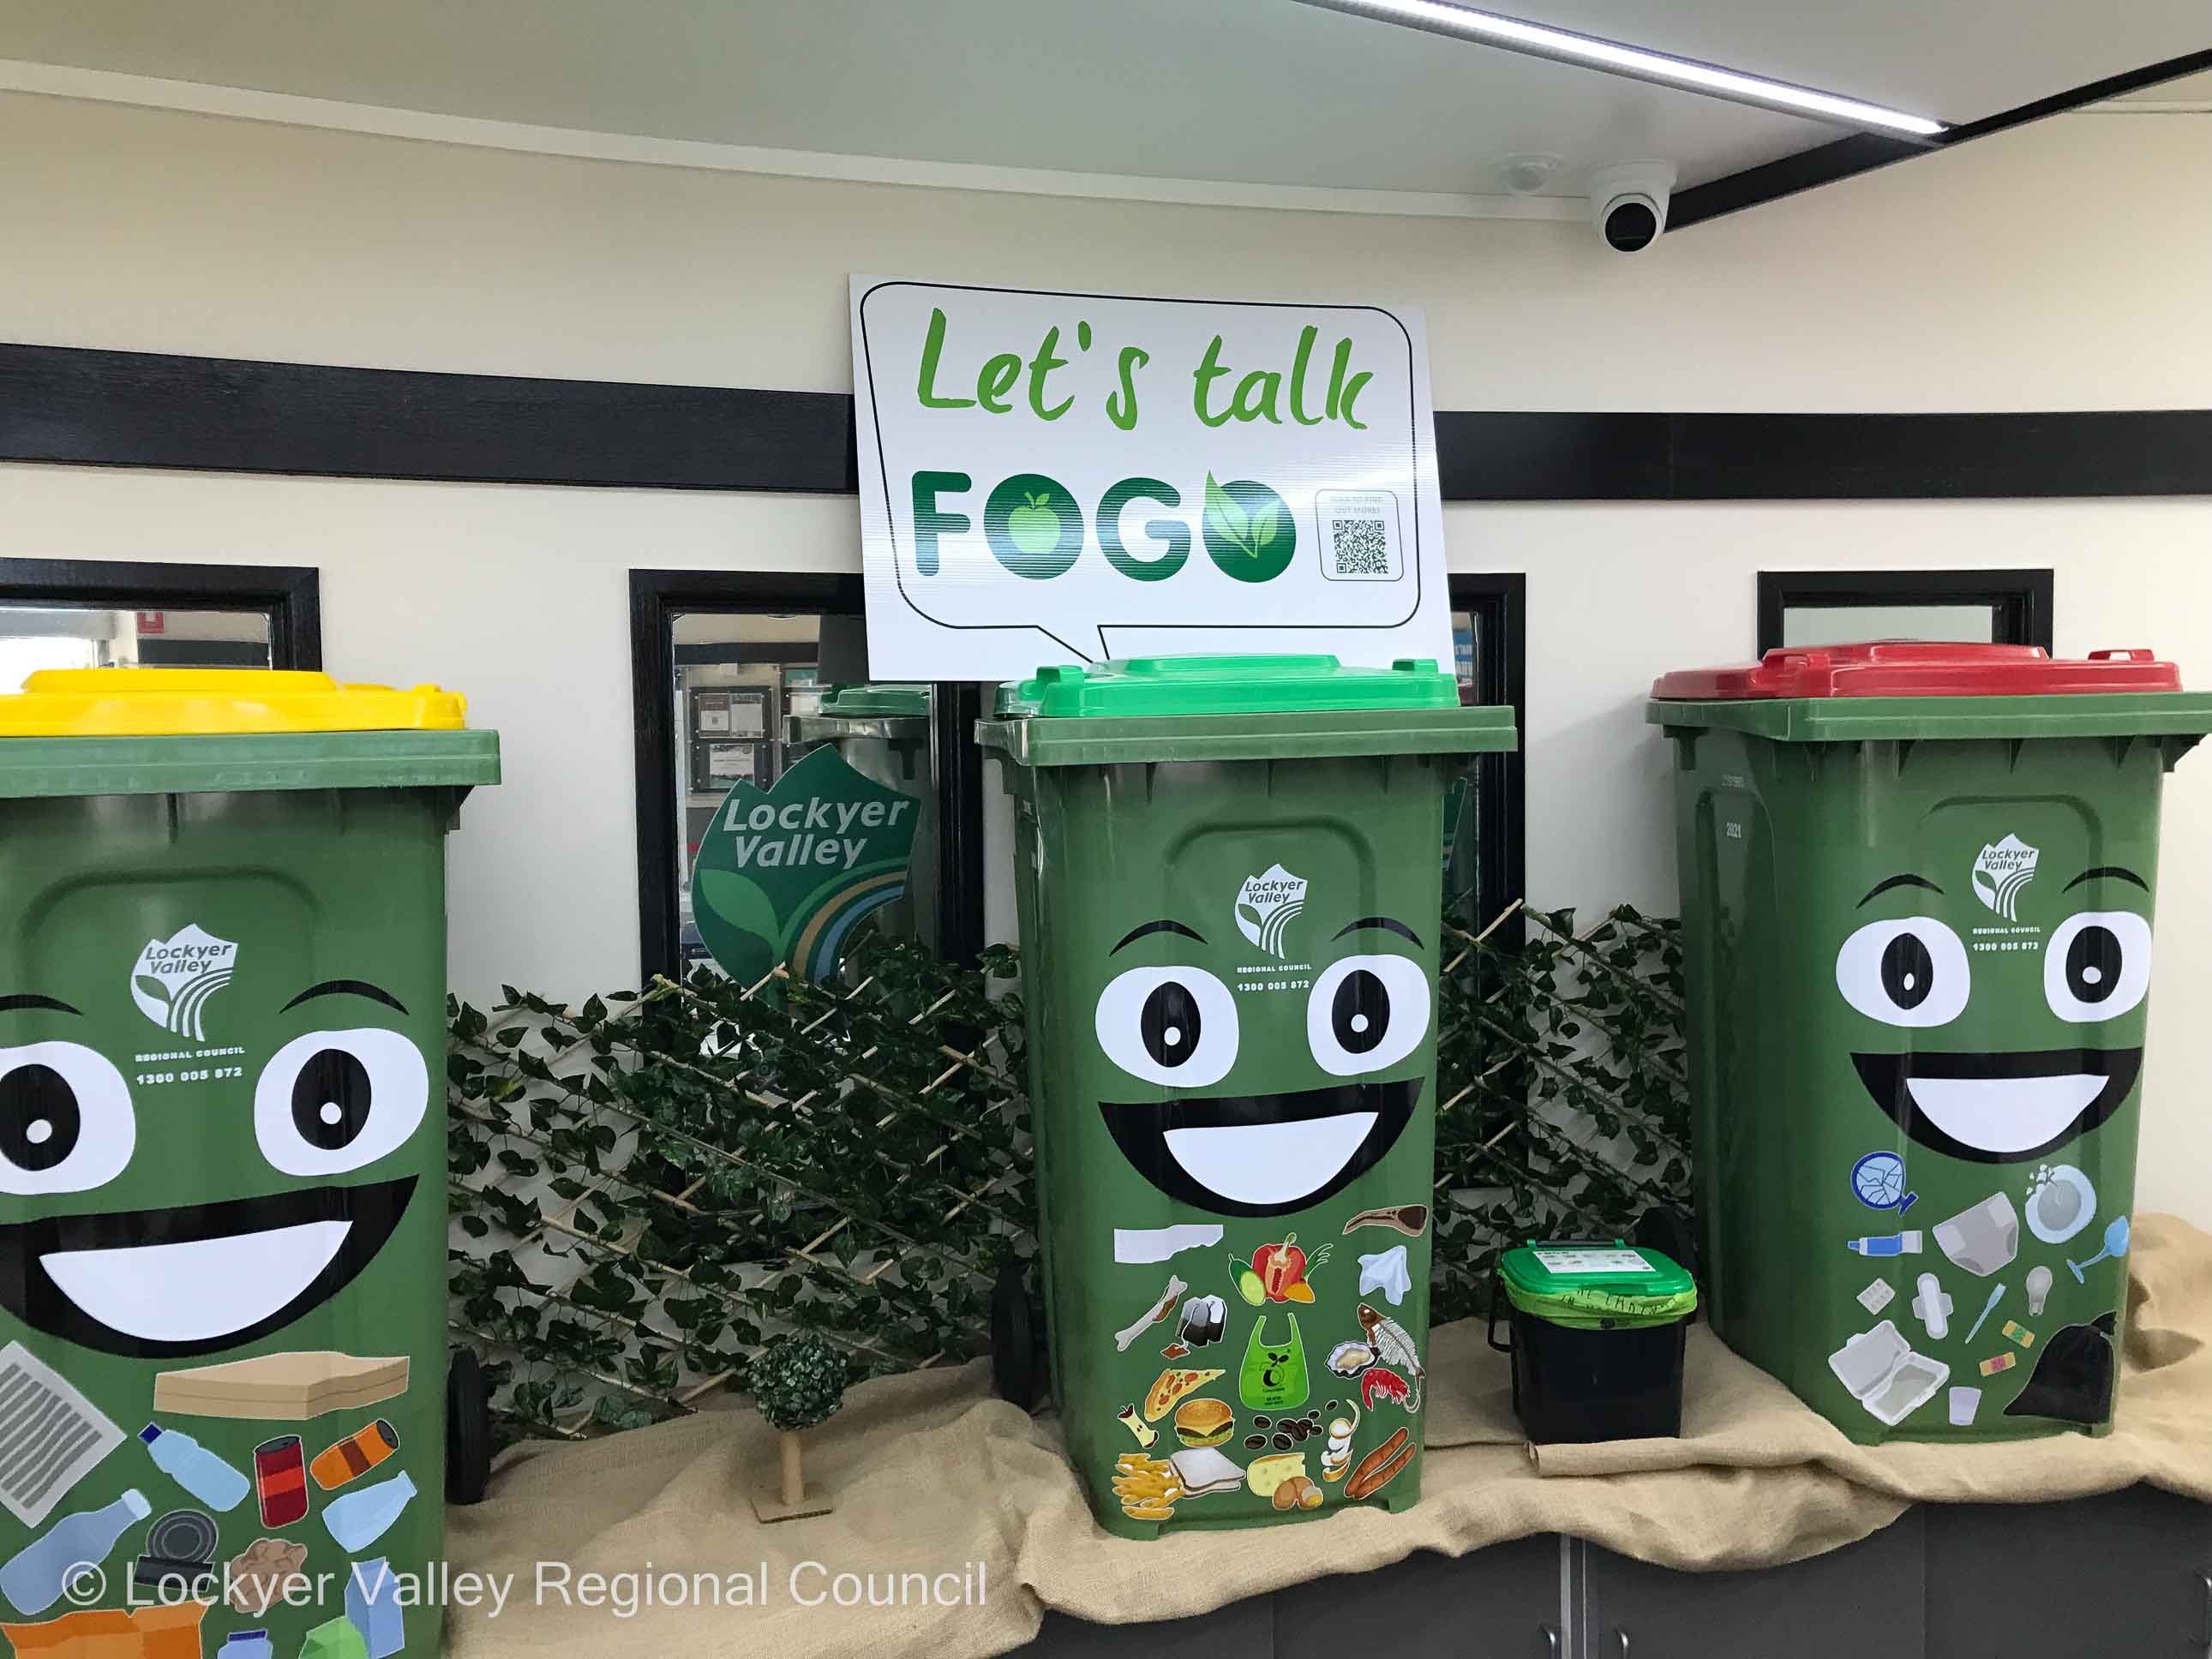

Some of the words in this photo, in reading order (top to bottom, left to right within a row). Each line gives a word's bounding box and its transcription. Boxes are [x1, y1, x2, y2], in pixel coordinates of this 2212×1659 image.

[917, 307, 1150, 431] Let's
[1193, 324, 1375, 430] talk
[910, 469, 1298, 584] FOGO
[722, 796, 910, 835] Lockyer
[734, 833, 868, 871] Valley
[1981, 848, 2035, 861] Lockyer
[1984, 859, 2023, 871] Valley
[1244, 879, 1304, 893] Lockyer
[1248, 892, 1291, 904] Valley
[145, 943, 233, 961] Lockyer
[149, 959, 213, 975] Valley
[1237, 965, 1276, 974] REGIONAL
[1278, 963, 1313, 972] COUNCIL
[1237, 982, 1263, 992] 1300
[1291, 979, 1310, 989] 872
[135, 1050, 194, 1063] REGIONAL
[195, 1045, 247, 1058] COUNCIL
[136, 1072, 175, 1086] 1300
